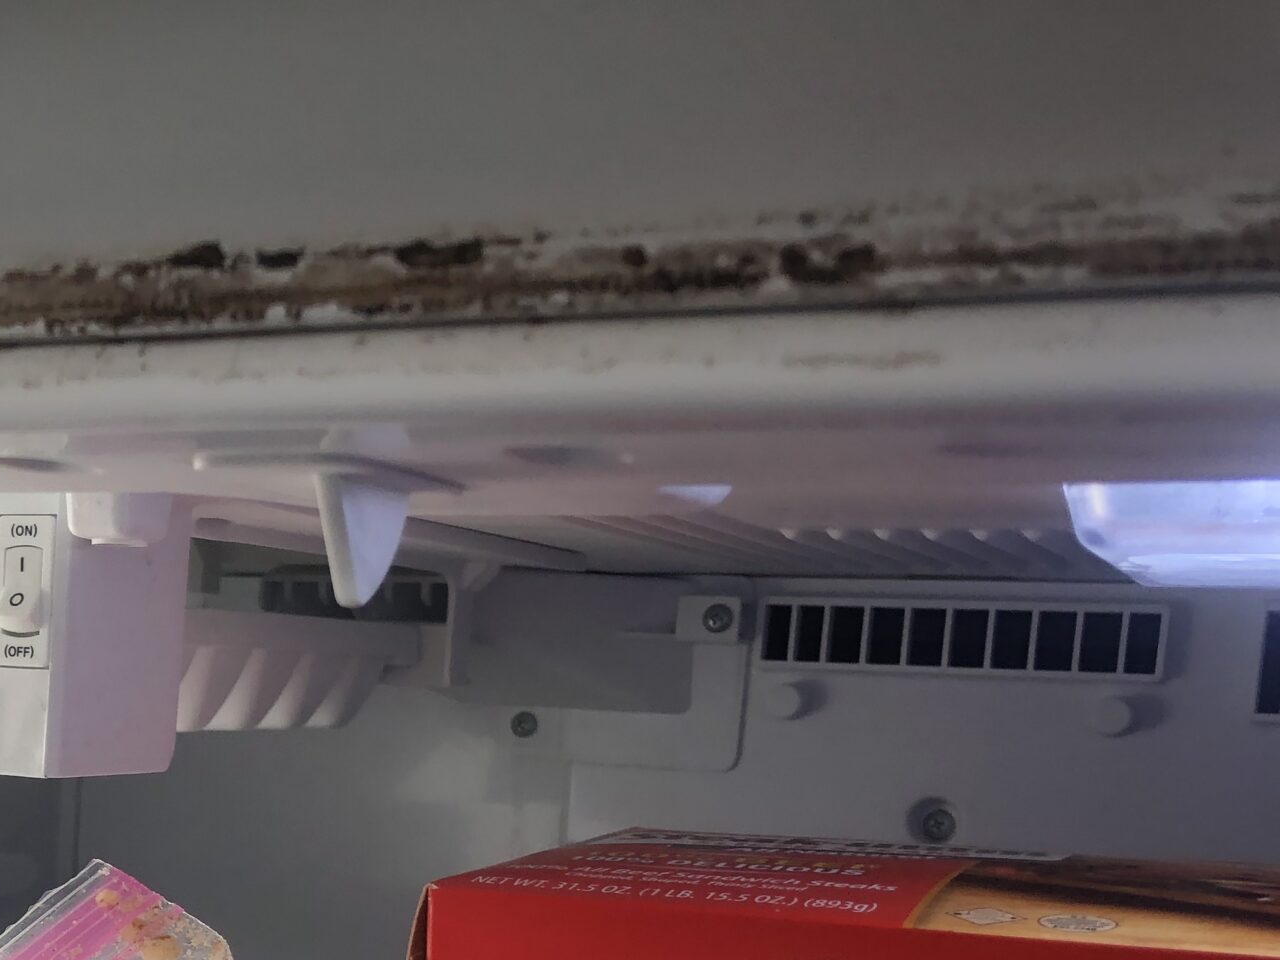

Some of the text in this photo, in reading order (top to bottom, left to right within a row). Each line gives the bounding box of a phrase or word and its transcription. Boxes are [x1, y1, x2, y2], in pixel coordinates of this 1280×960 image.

[10, 523, 38, 538] (ON)
[3, 643, 35, 659] (OFF)
[666, 859, 866, 876] DELICIOUS
[611, 867, 669, 877] Beef
[670, 871, 802, 885] Sandwich
[808, 879, 899, 892] Steaks
[471, 875, 879, 914] NET WT. 31.5 OZ. (1 LB. 15.5 OZ.) (893g)
